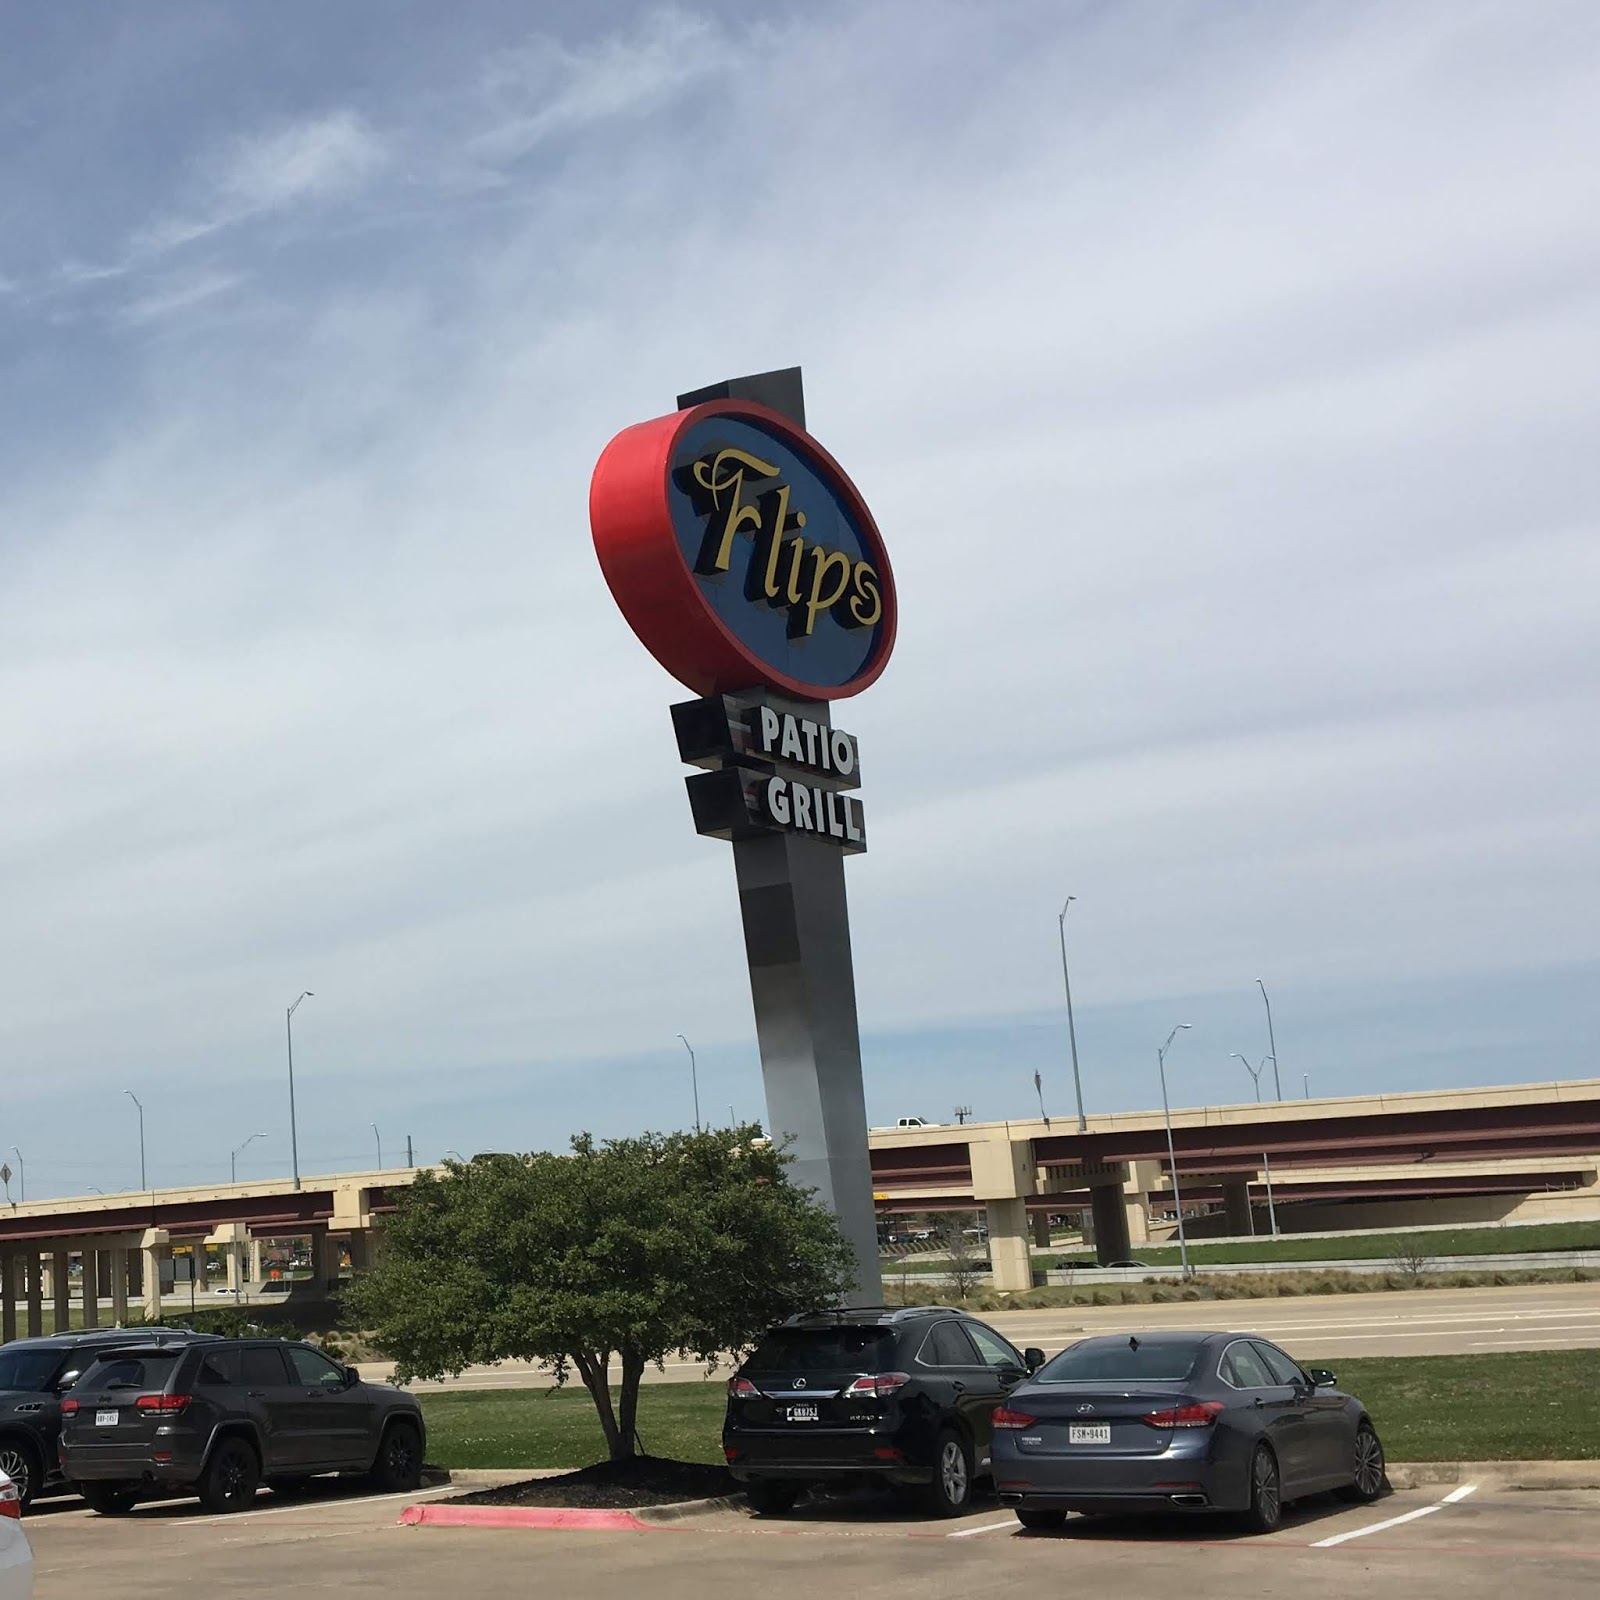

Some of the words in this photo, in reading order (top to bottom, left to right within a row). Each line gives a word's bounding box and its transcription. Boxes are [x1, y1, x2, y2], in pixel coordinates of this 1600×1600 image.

[692, 449, 881, 635] Flips
[761, 706, 854, 776] PATIO
[767, 775, 863, 841] GRILL
